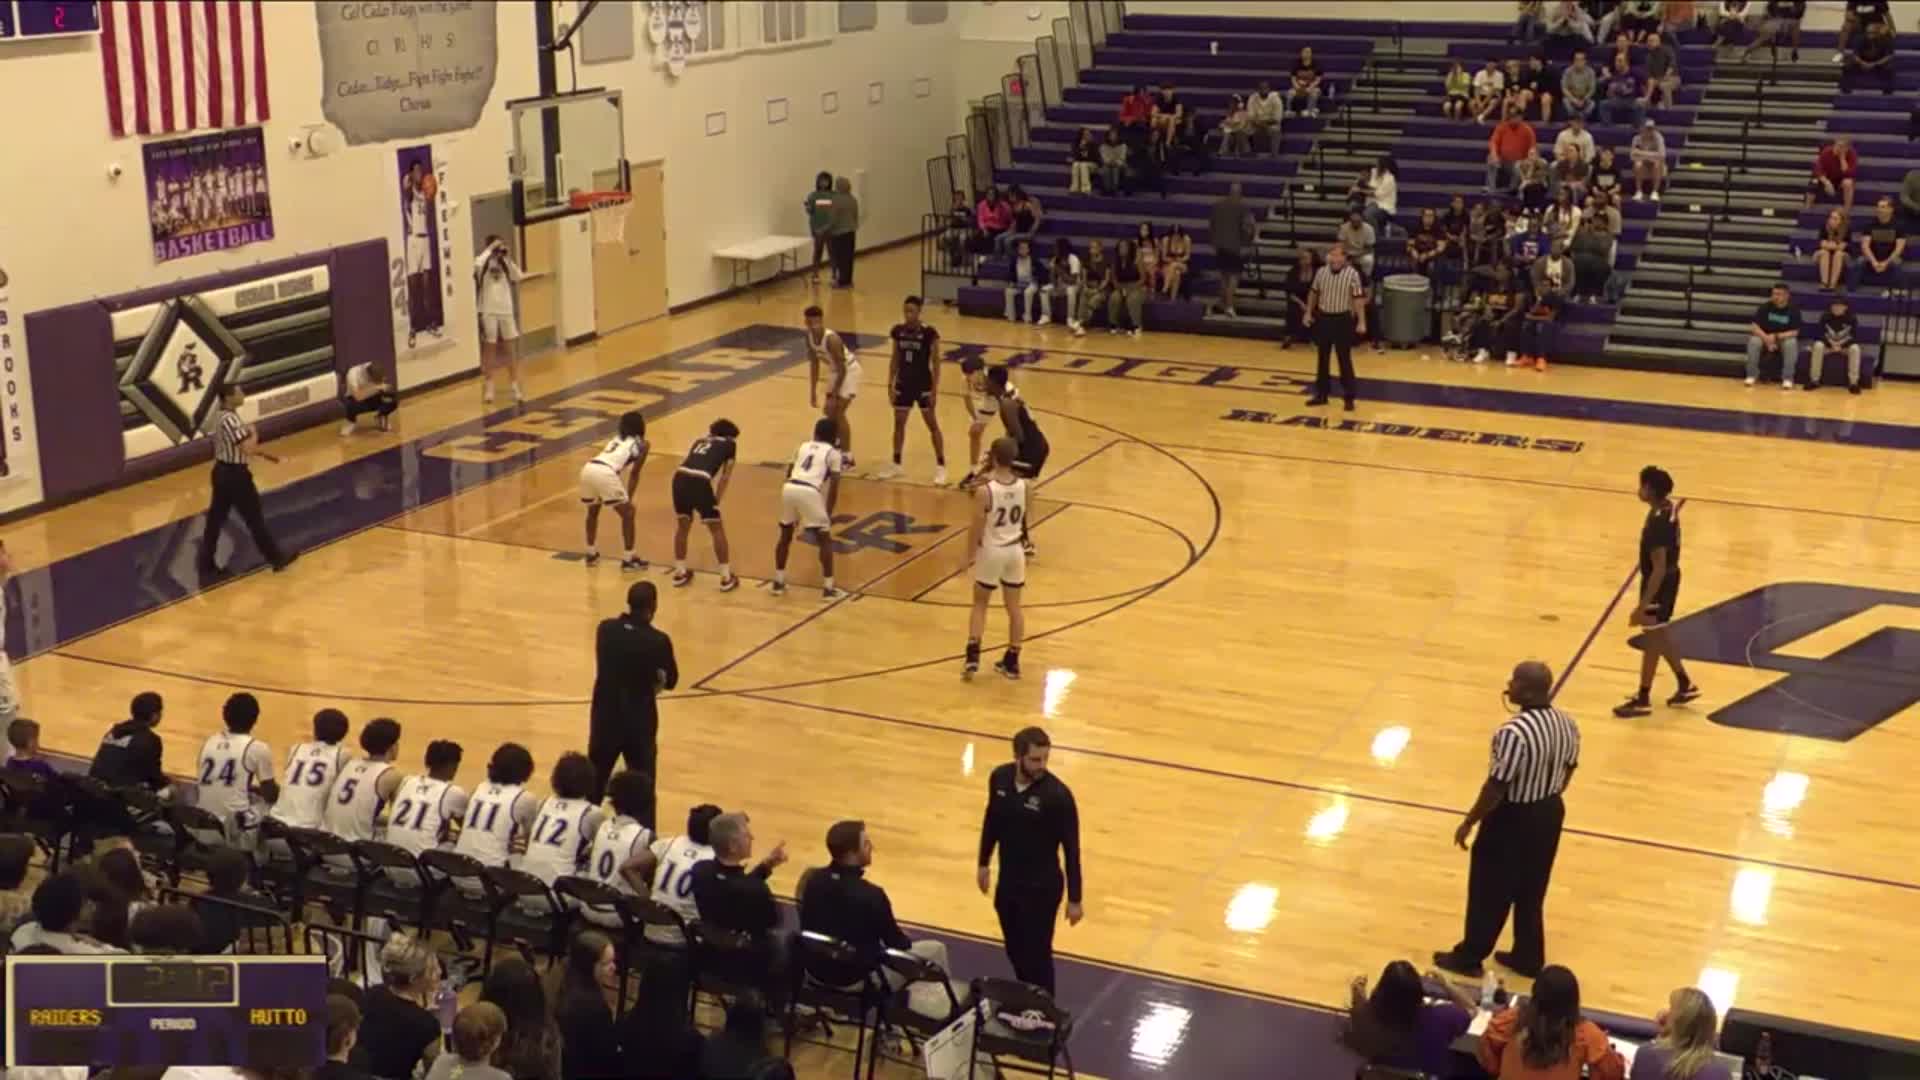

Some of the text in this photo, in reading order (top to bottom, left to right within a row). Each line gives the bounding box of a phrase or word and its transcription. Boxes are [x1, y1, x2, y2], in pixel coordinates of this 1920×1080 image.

[54, 6, 65, 29] 2
[154, 221, 270, 261] BASKETBALL
[420, 347, 792, 464] CEDAR
[1221, 408, 1584, 453] RAIDERS
[800, 453, 815, 472] 4
[994, 504, 1022, 528] 20
[201, 757, 236, 787] 24
[289, 760, 327, 787] 15
[337, 778, 359, 804] 5
[392, 799, 432, 830] 21
[465, 799, 501, 832] 11
[532, 815, 569, 846] 12
[598, 849, 615, 880] 0
[658, 860, 694, 898] 10
